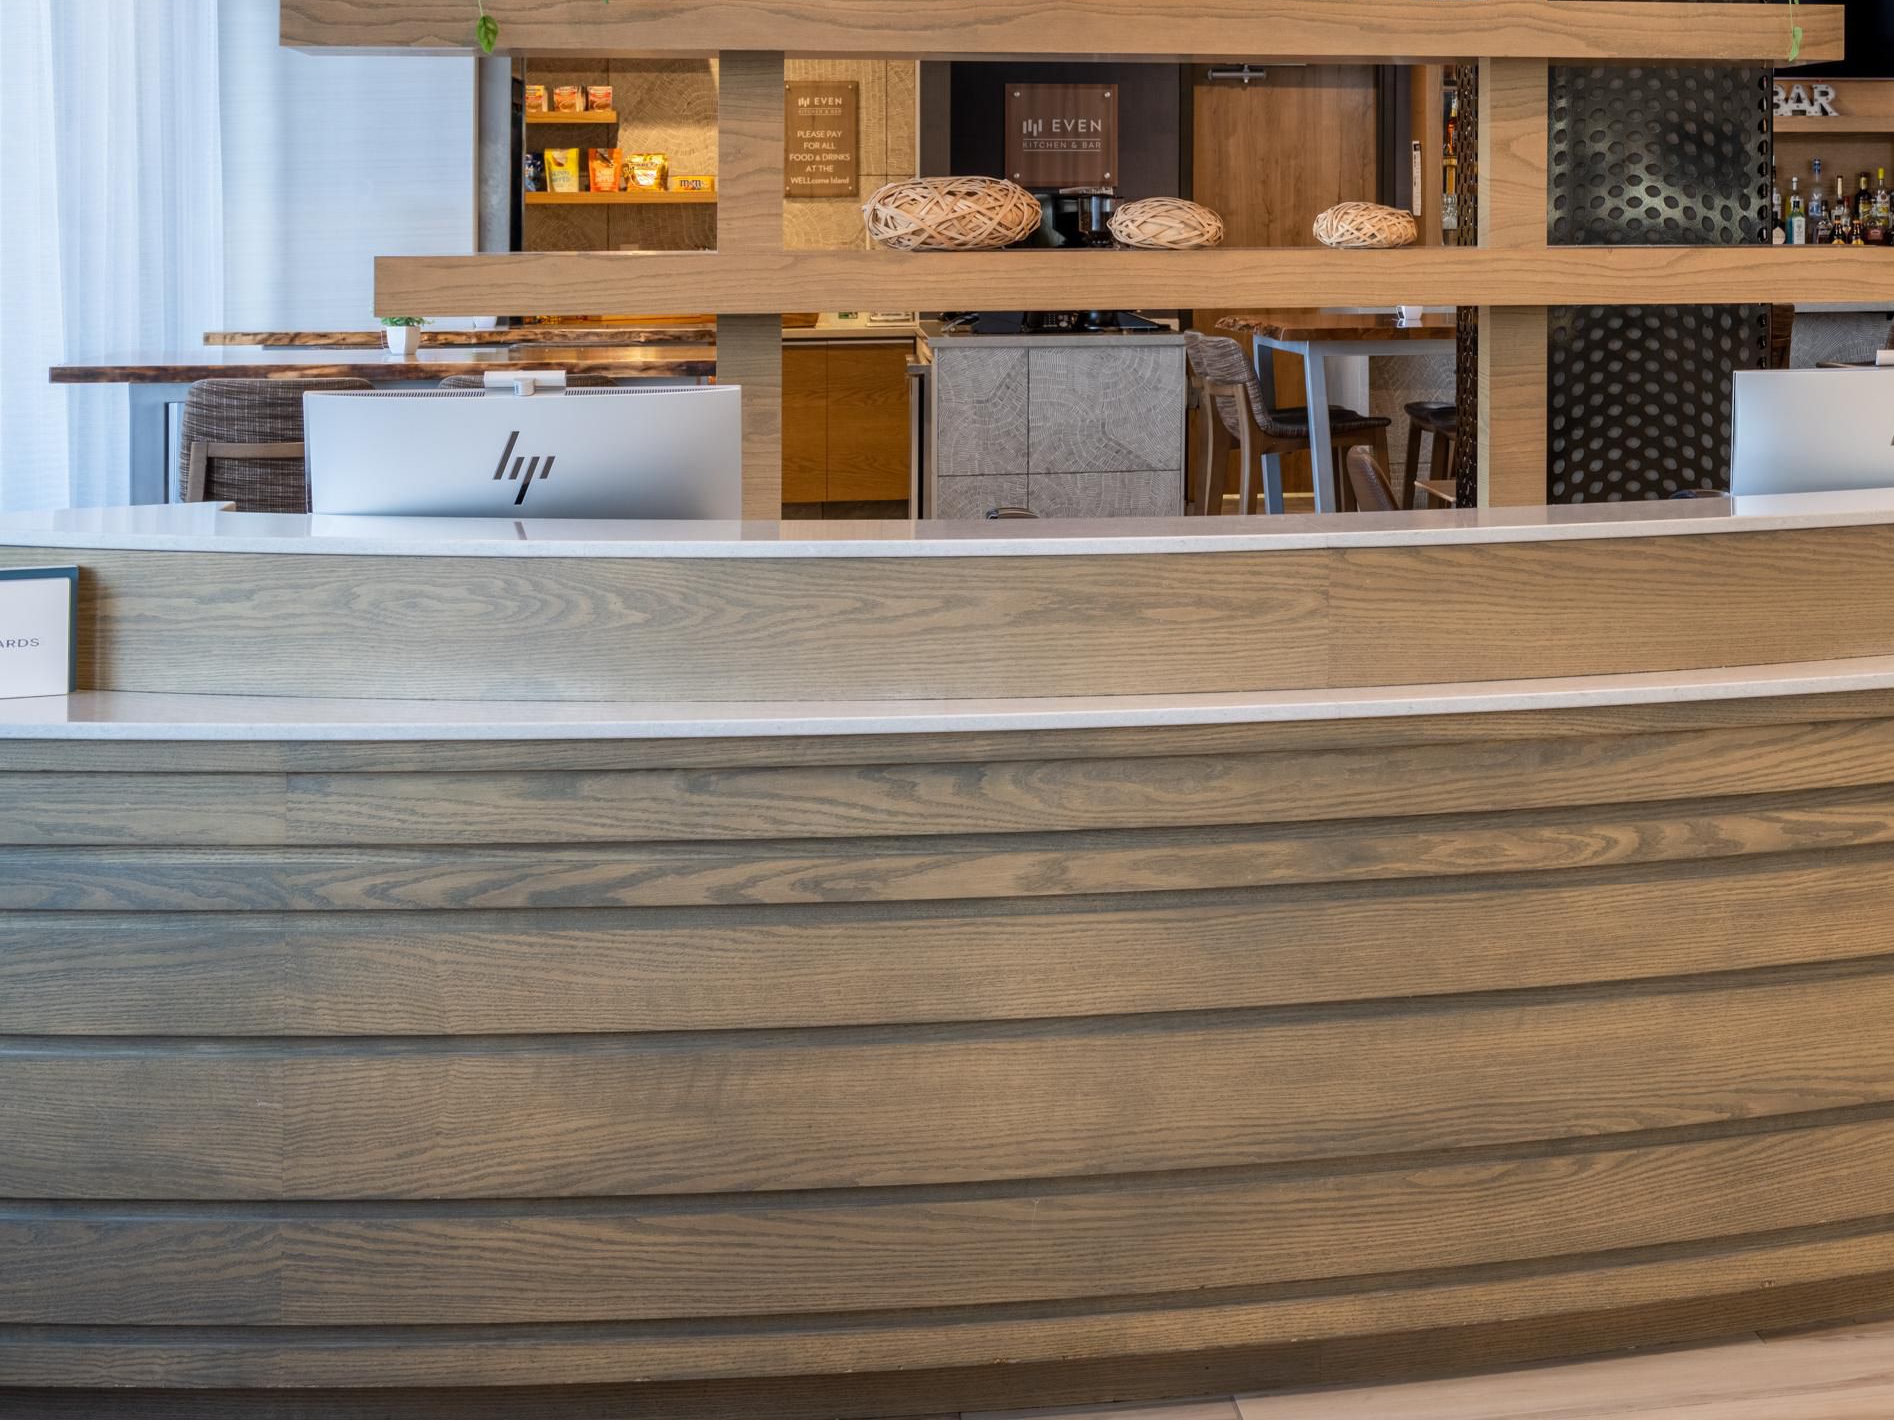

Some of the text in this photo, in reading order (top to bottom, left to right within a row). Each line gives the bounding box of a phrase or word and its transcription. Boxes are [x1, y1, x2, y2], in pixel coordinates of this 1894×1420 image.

[814, 97, 842, 106] EVEN
[1773, 84, 1839, 116] BAR
[1052, 119, 1102, 132] EVEN
[797, 130, 842, 138] PLEASE PAY
[1023, 141, 1101, 149] KITCHEN & BAR
[789, 153, 814, 161] FOOD
[822, 153, 851, 161] DRINKS
[790, 176, 850, 185] WELLcome Island
[493, 430, 556, 506] hp
